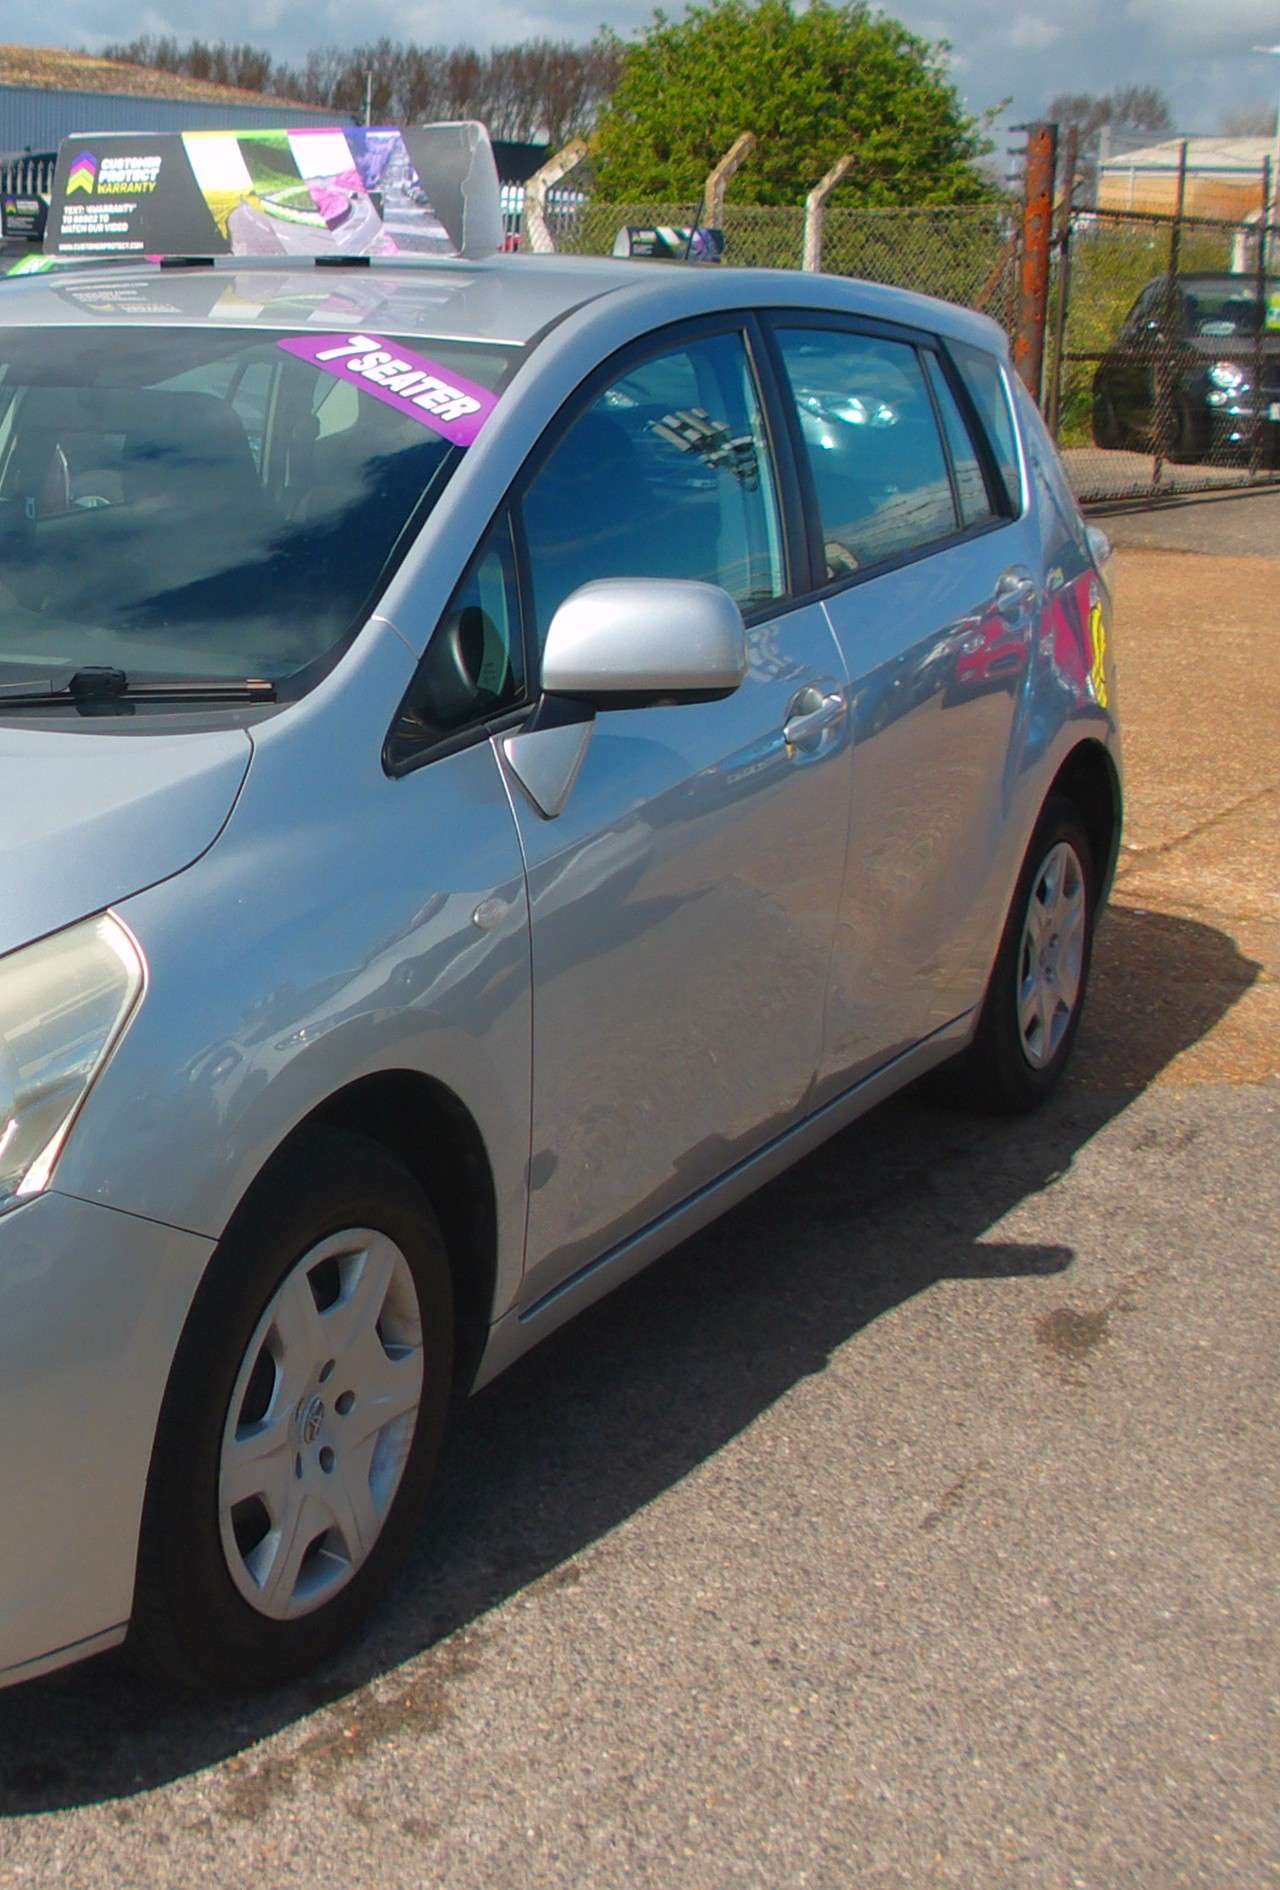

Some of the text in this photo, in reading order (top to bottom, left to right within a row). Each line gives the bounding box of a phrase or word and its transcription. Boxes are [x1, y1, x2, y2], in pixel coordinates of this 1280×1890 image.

[101, 157, 161, 170] CUSTOMER
[99, 168, 160, 182] PROTECT
[98, 182, 156, 194] WARRANTY
[315, 335, 481, 422] 7 SEATER
